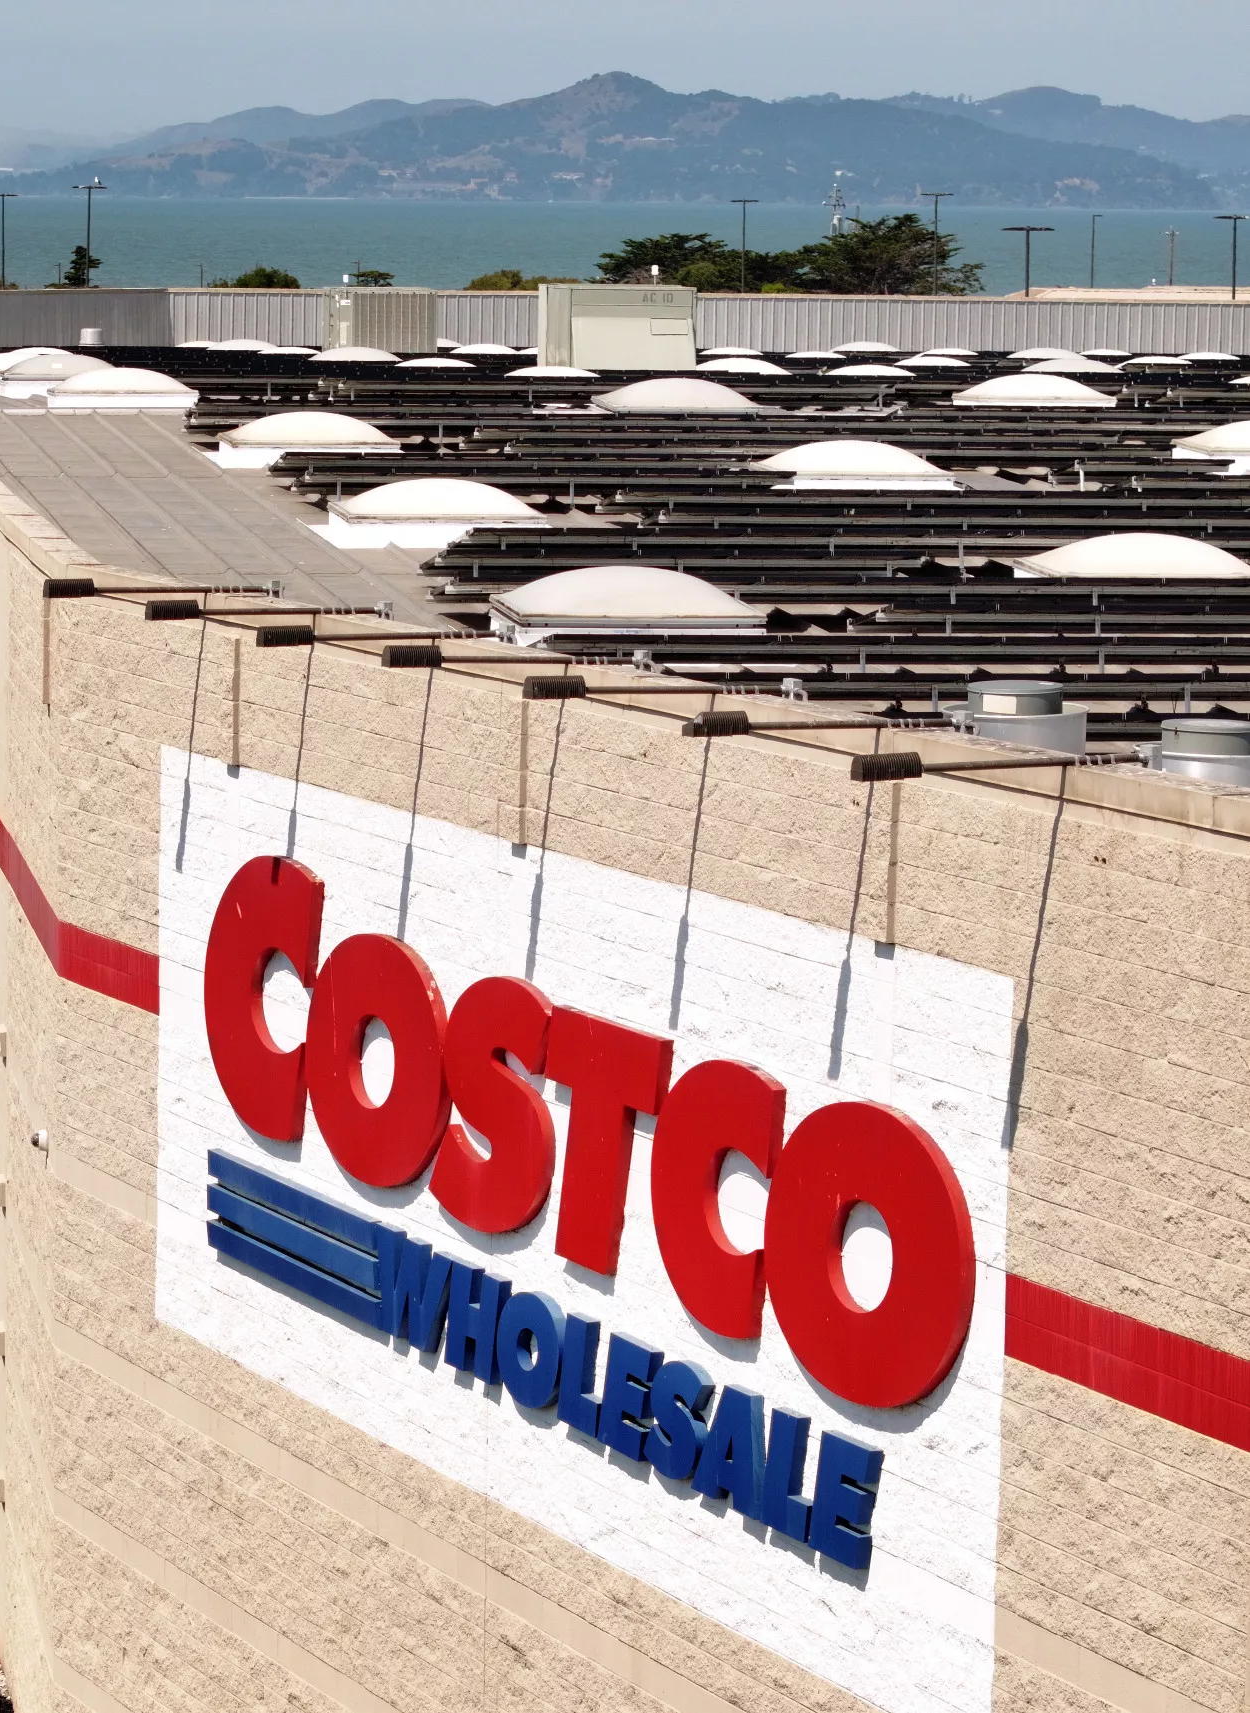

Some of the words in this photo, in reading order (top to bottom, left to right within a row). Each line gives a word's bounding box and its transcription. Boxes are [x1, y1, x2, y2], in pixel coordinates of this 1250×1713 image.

[642, 292, 656, 303] AC
[204, 855, 976, 1407] COSTCO
[378, 1222, 884, 1570] WHOLESALE
